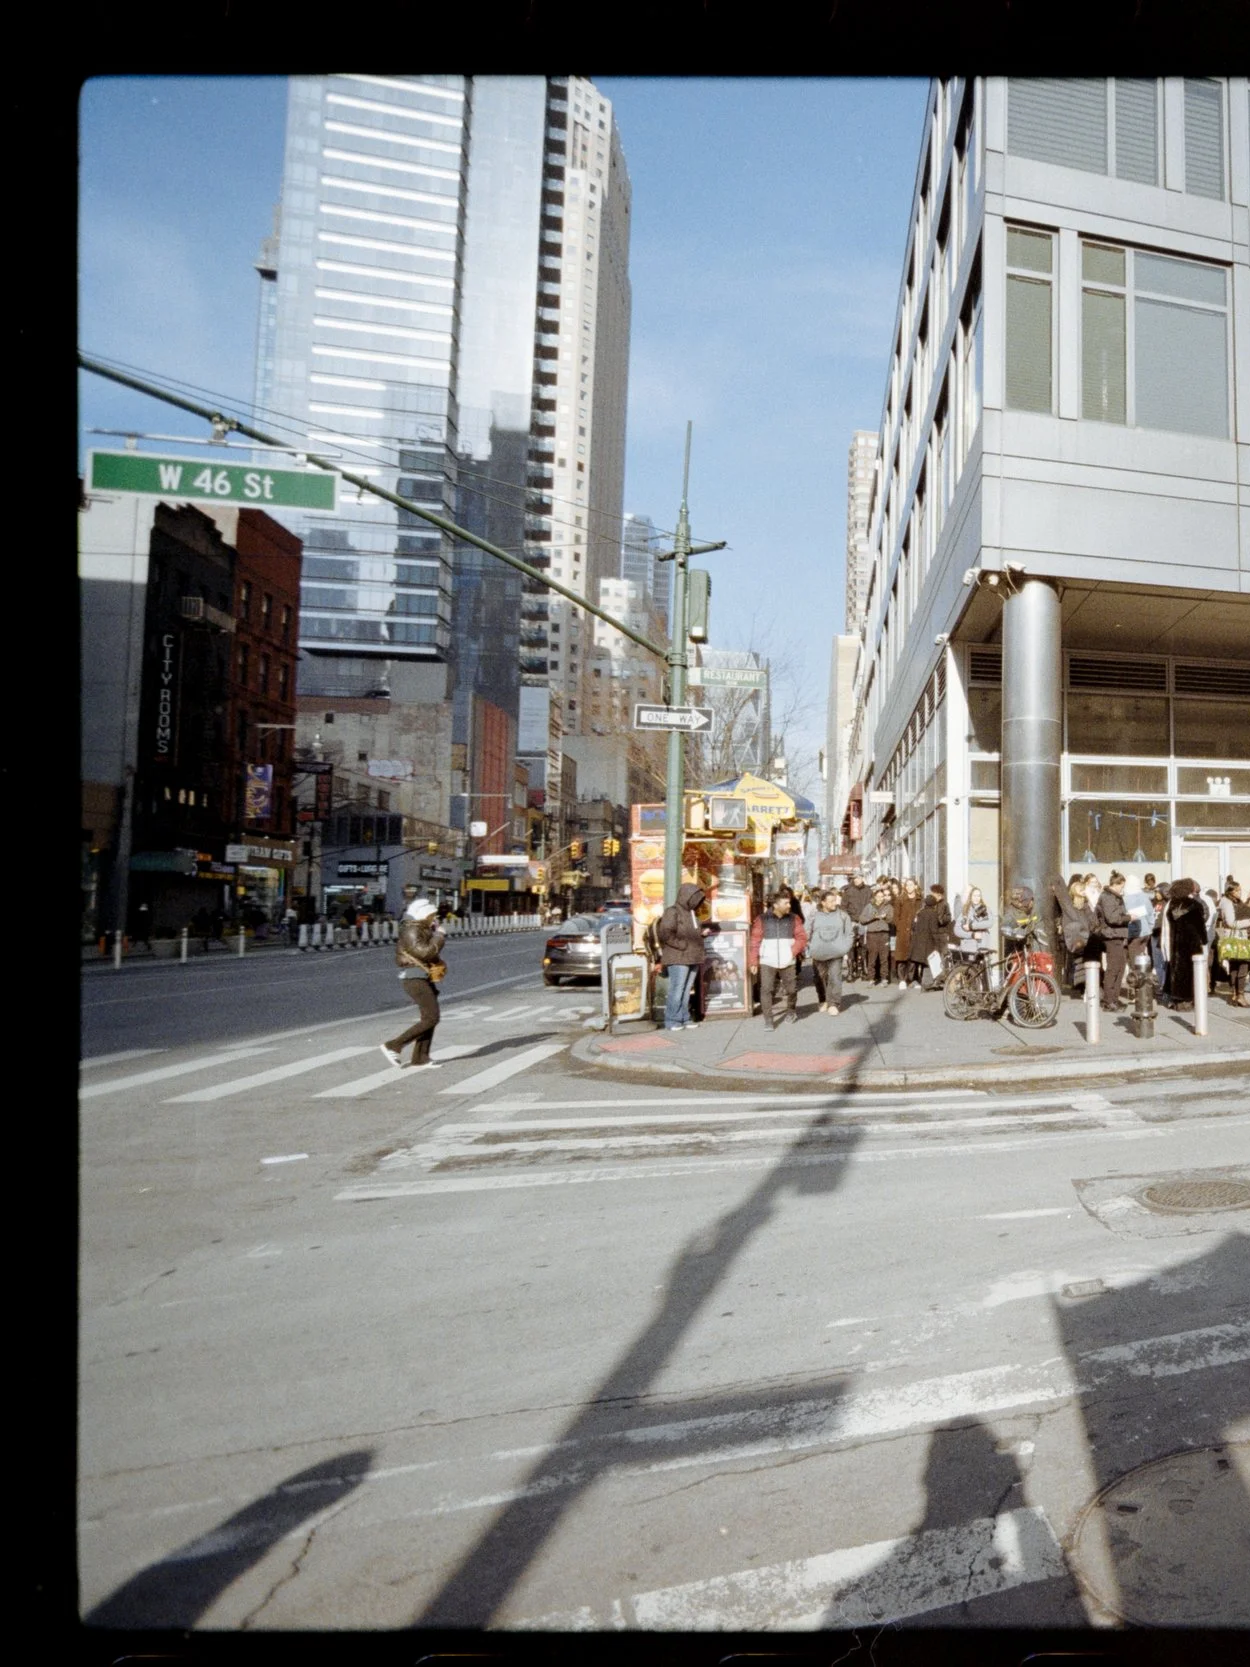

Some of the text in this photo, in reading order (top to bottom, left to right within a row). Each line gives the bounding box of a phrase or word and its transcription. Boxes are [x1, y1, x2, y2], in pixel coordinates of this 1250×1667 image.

[159, 463, 274, 499] W 46 St
[161, 633, 175, 686] CITY
[703, 670, 760, 682] RESTAURANT
[156, 688, 172, 753] ROOMS
[647, 712, 702, 725] ONE WAY
[747, 804, 789, 815] BRETT
